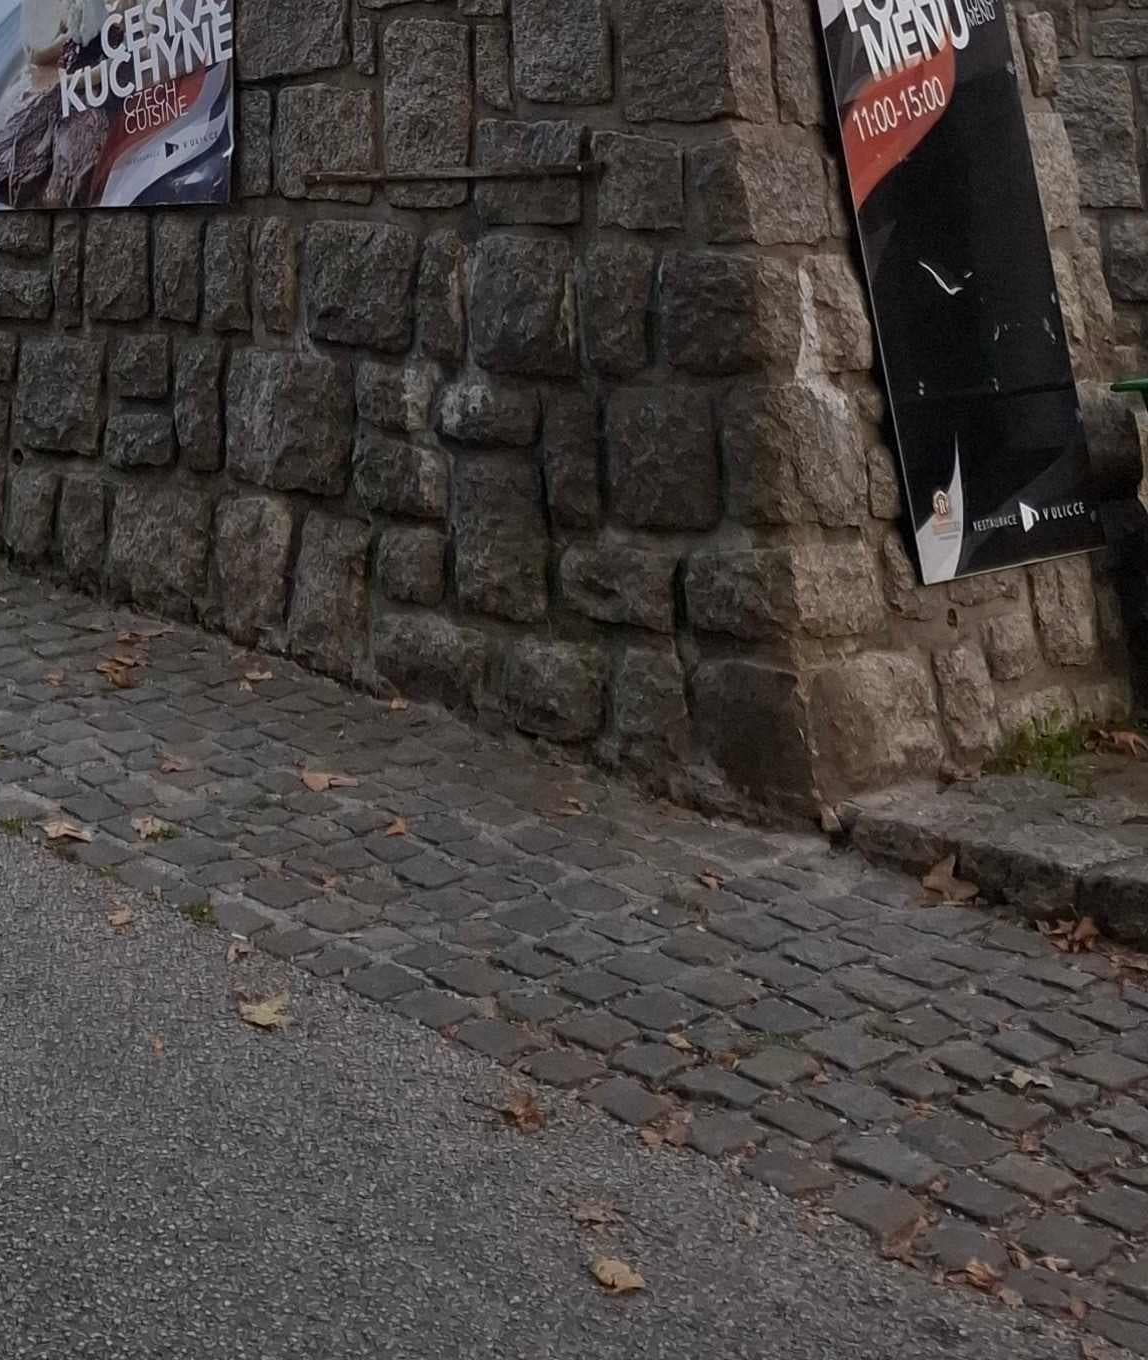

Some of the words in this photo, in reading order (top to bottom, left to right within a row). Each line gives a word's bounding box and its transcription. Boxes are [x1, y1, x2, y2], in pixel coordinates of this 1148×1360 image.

[59, 0, 233, 119] KUCHYNĚ
[123, 80, 177, 115] CZECH
[124, 95, 189, 134] CUISINE
[853, 76, 946, 143] 11:00-15:00
